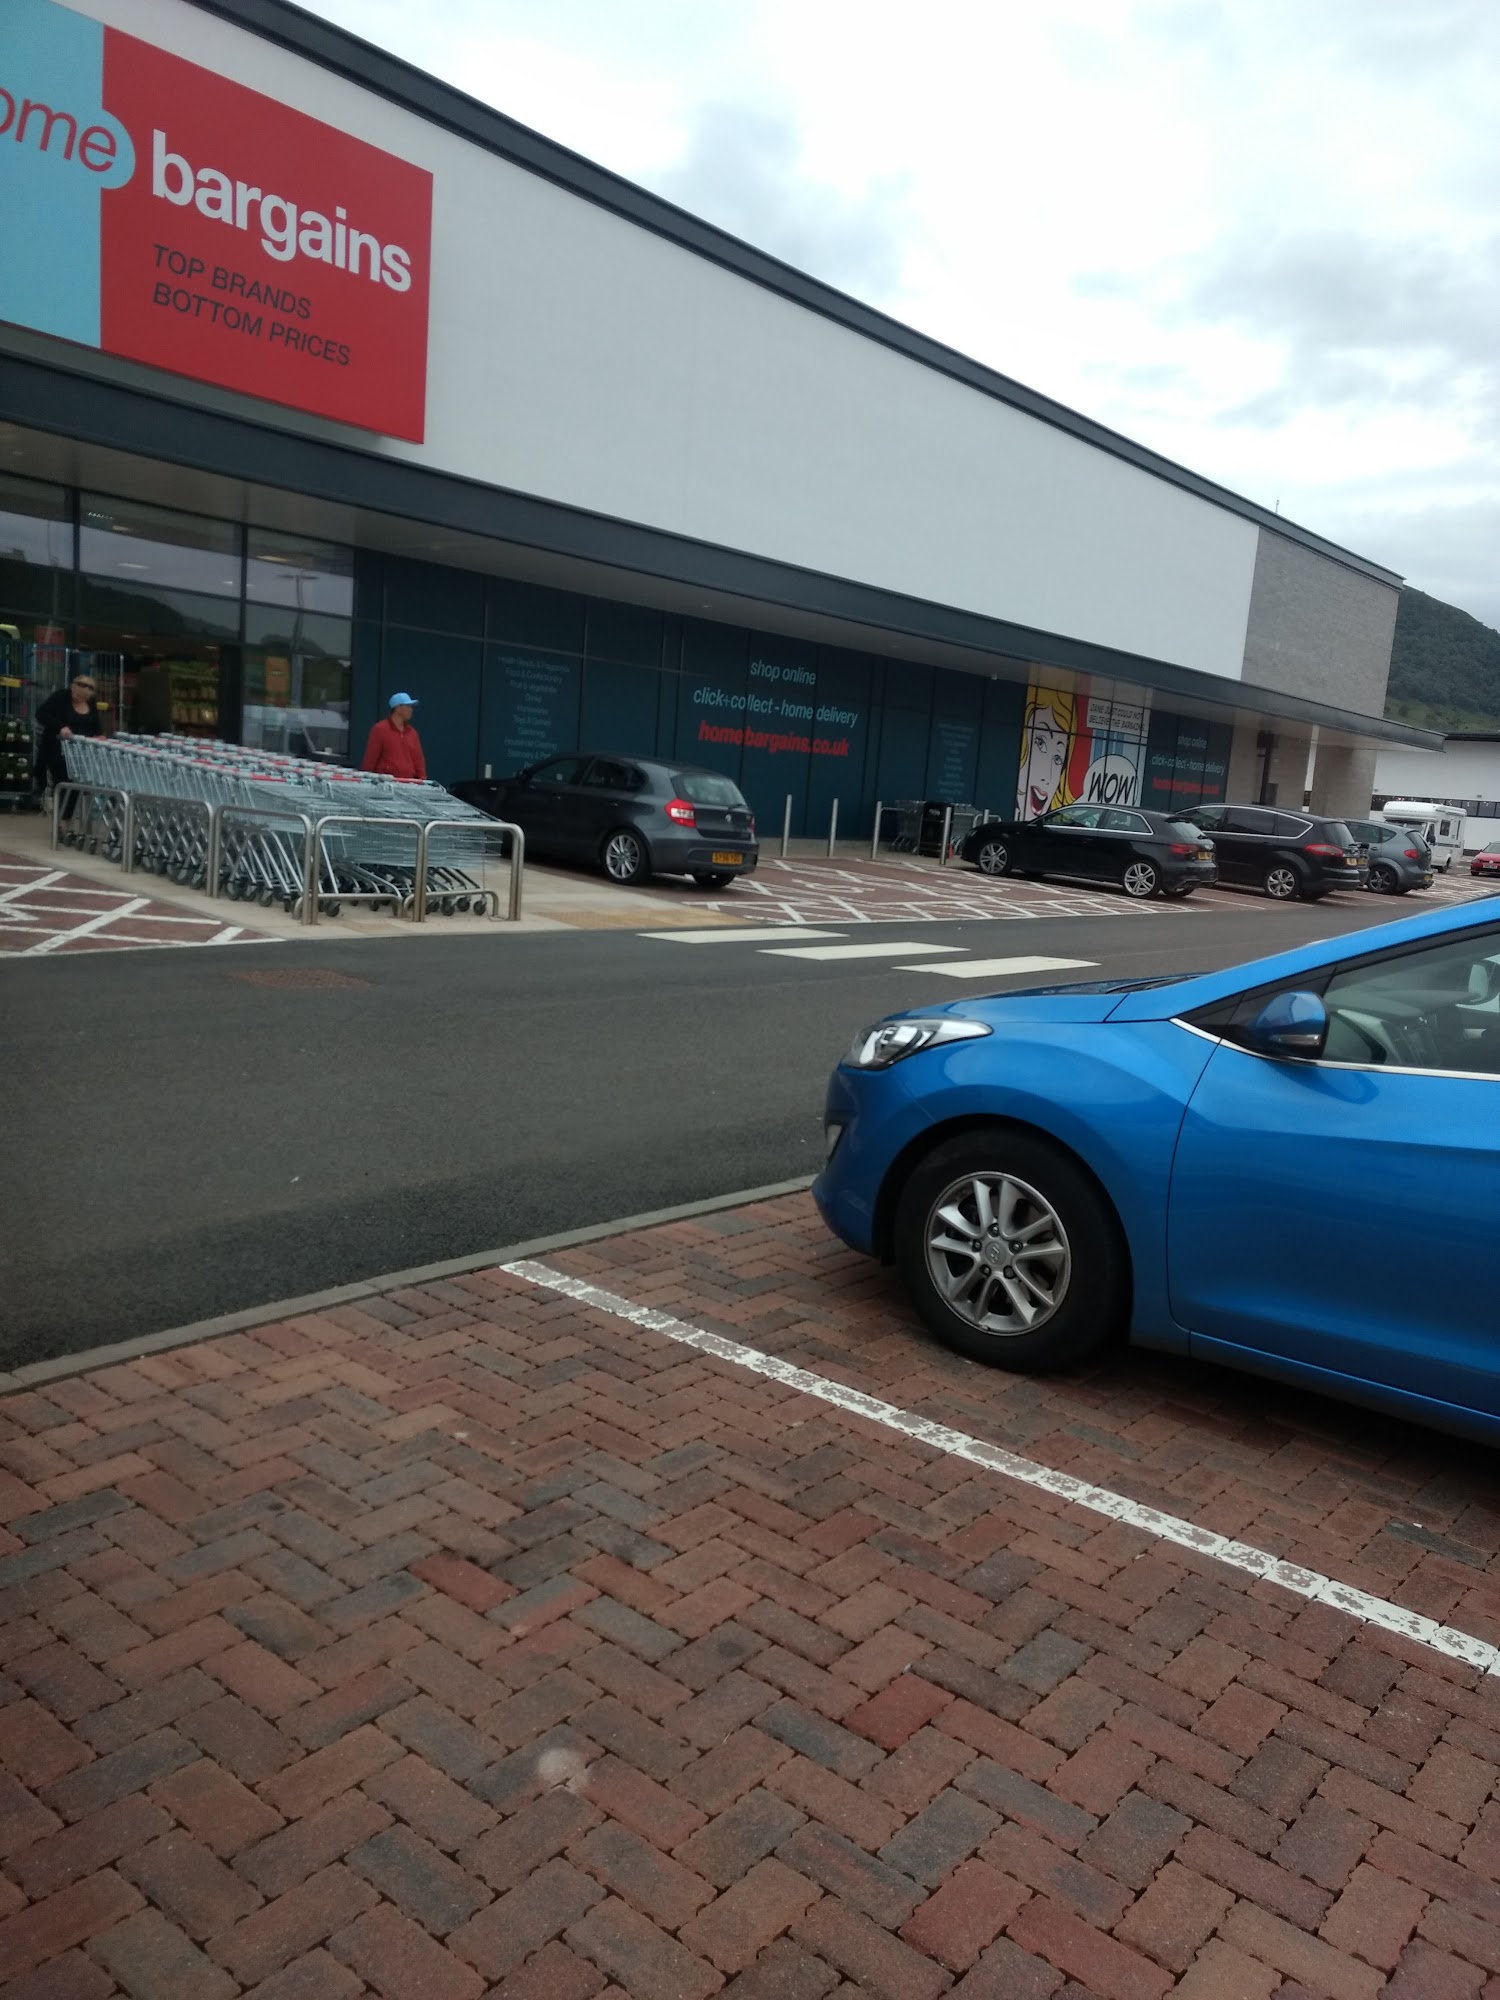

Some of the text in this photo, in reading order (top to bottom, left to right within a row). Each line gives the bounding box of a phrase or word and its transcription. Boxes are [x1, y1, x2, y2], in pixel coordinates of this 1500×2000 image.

[152, 128, 411, 292] bargains
[153, 244, 311, 319] TOP BRANDS
[153, 282, 350, 366] BOTTOM PRICES
[750, 659, 817, 685] shop online
[781, 702, 814, 719] home
[816, 704, 858, 728] delivery
[1090, 703, 1104, 713] JANE
[1111, 718, 1121, 727] THE
